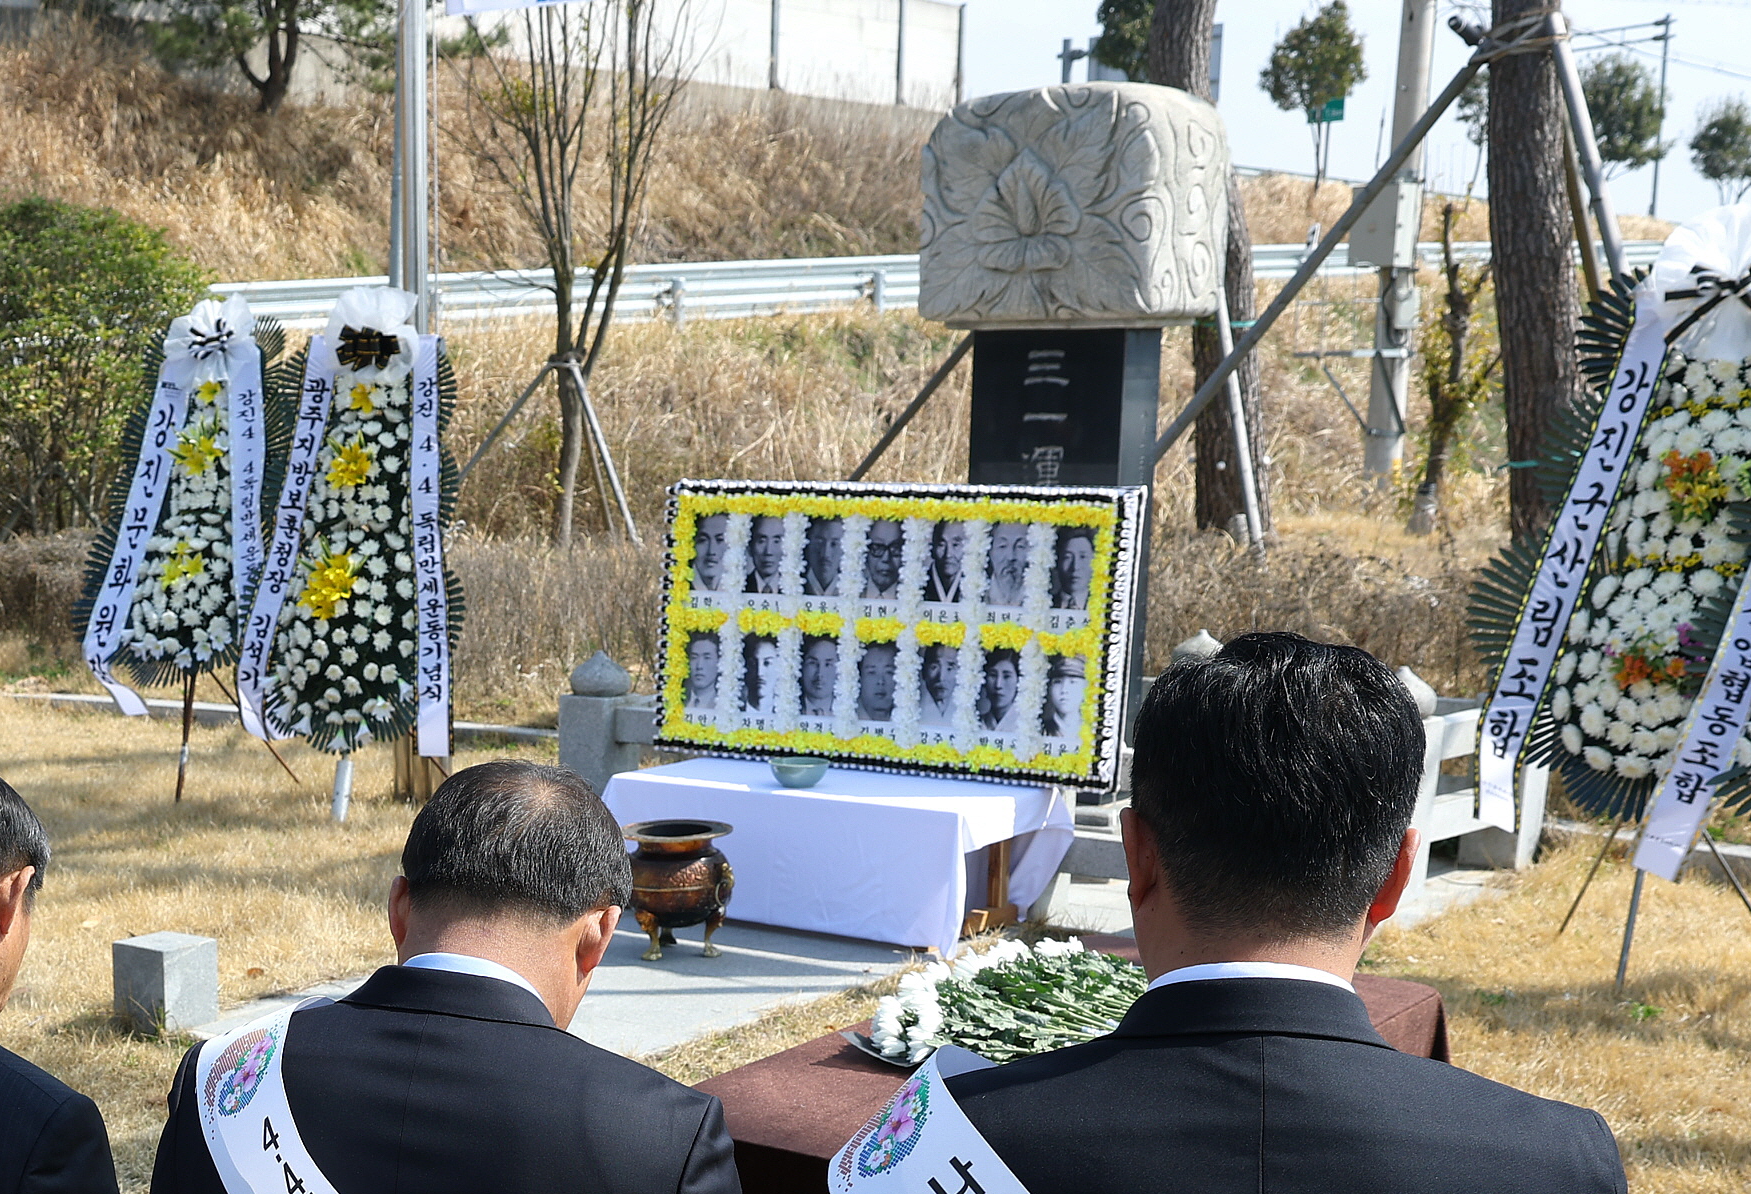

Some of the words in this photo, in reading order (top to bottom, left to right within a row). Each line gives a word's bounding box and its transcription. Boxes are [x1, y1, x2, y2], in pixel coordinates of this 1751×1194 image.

[265, 377, 330, 593] 광주지방보훈청장
[416, 378, 437, 417] 강진
[415, 512, 445, 702] 독립만세운동기념식
[1490, 362, 1649, 759] 강진군산림조합
